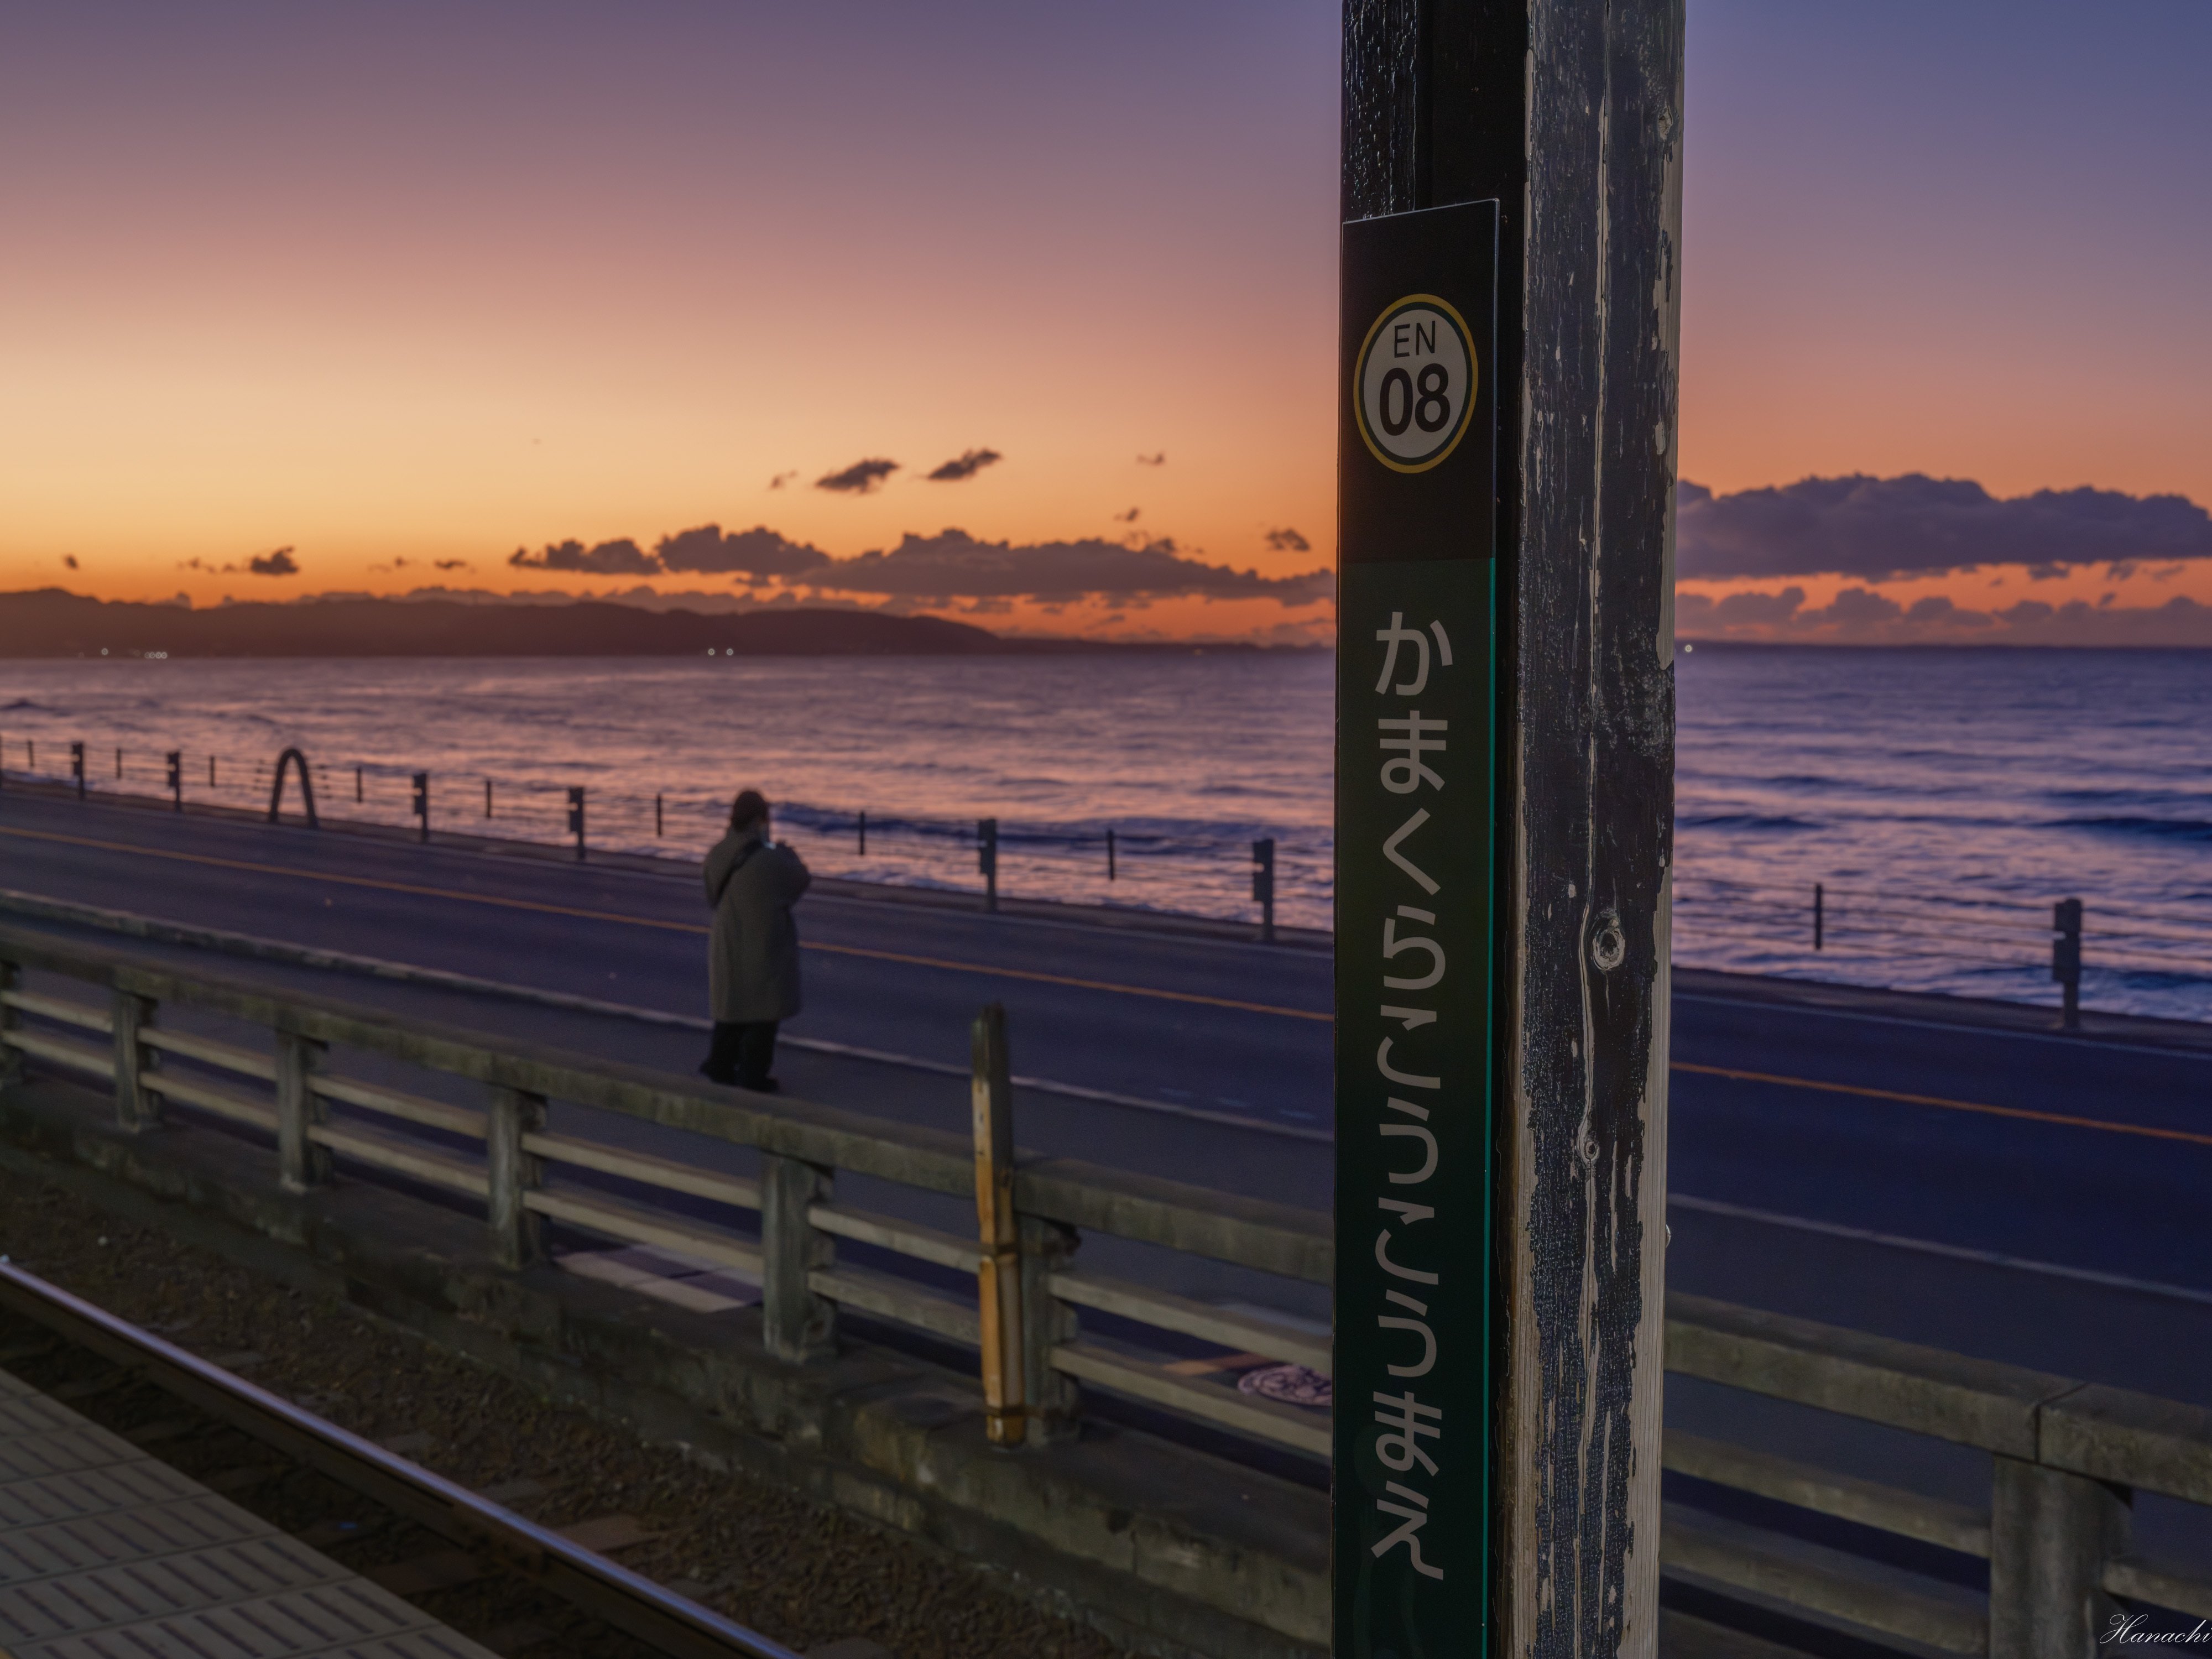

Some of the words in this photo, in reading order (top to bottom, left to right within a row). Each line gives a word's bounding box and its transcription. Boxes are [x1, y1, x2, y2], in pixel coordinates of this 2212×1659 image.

[1394, 320, 1436, 358] EN
[1379, 363, 1451, 436] 08
[1370, 611, 1453, 1581] かまくらこうこうまえ
